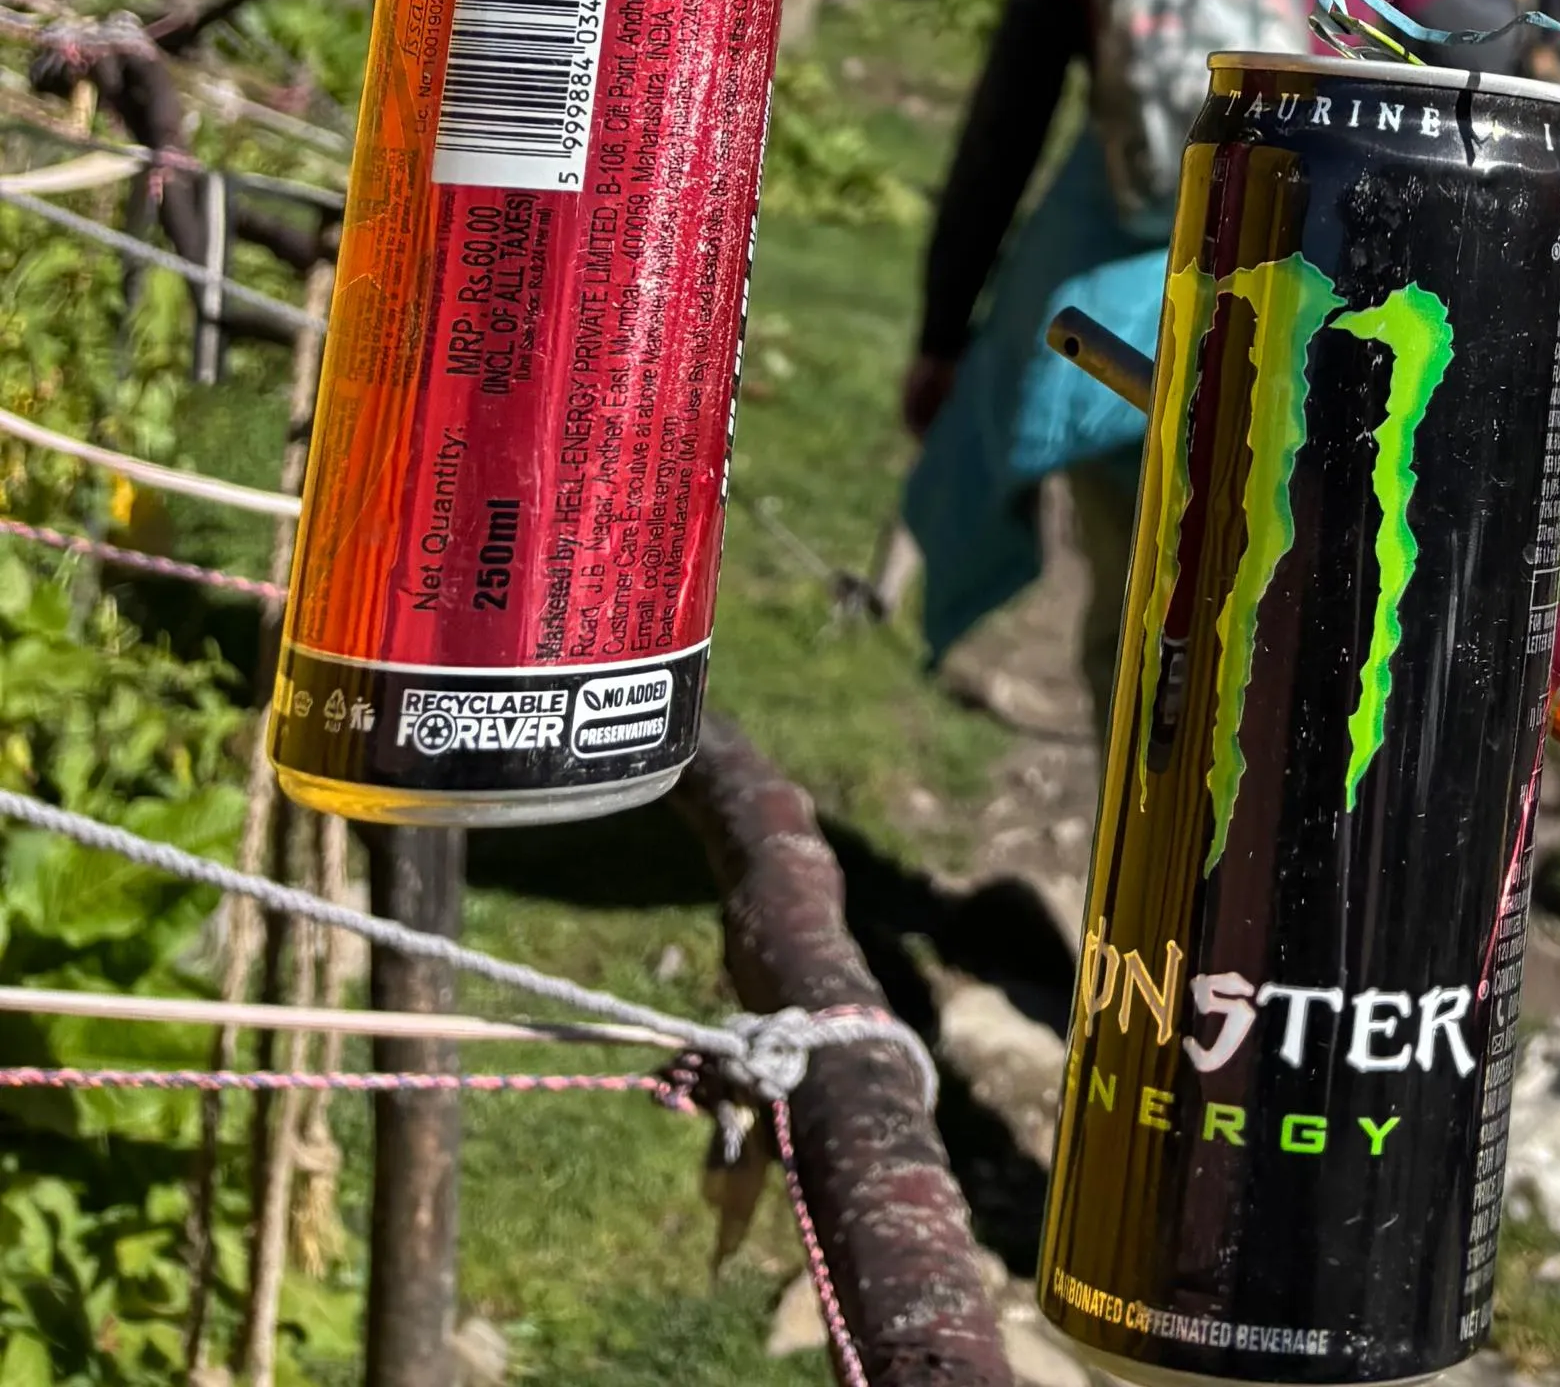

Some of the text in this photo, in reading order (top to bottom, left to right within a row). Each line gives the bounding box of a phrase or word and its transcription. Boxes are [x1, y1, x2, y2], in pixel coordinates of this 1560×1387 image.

[562, 57, 595, 151] 999884
[1224, 89, 1442, 139] TAURINE
[558, 171, 579, 184] 5
[500, 193, 542, 260] TAXES)
[494, 266, 525, 304] ALL
[490, 307, 518, 335] OF
[609, 284, 640, 356] Mumbai
[535, 566, 571, 660] Marketed
[573, 291, 608, 373] PRIVATE
[623, 440, 651, 523] Executive
[413, 426, 469, 612] Net Quantity:
[612, 526, 640, 568] Care
[663, 466, 694, 578] Manufacture
[472, 499, 521, 611] 250ml
[602, 573, 633, 655] Customer
[403, 691, 565, 714] RECYCLABLE
[601, 680, 668, 710] NO ADDED
[397, 712, 564, 755] FOREVER
[577, 716, 664, 746] PRESERVATIVES
[1053, 1266, 1330, 1356] CARBONATED CAFFEINATED BEVERAGE
